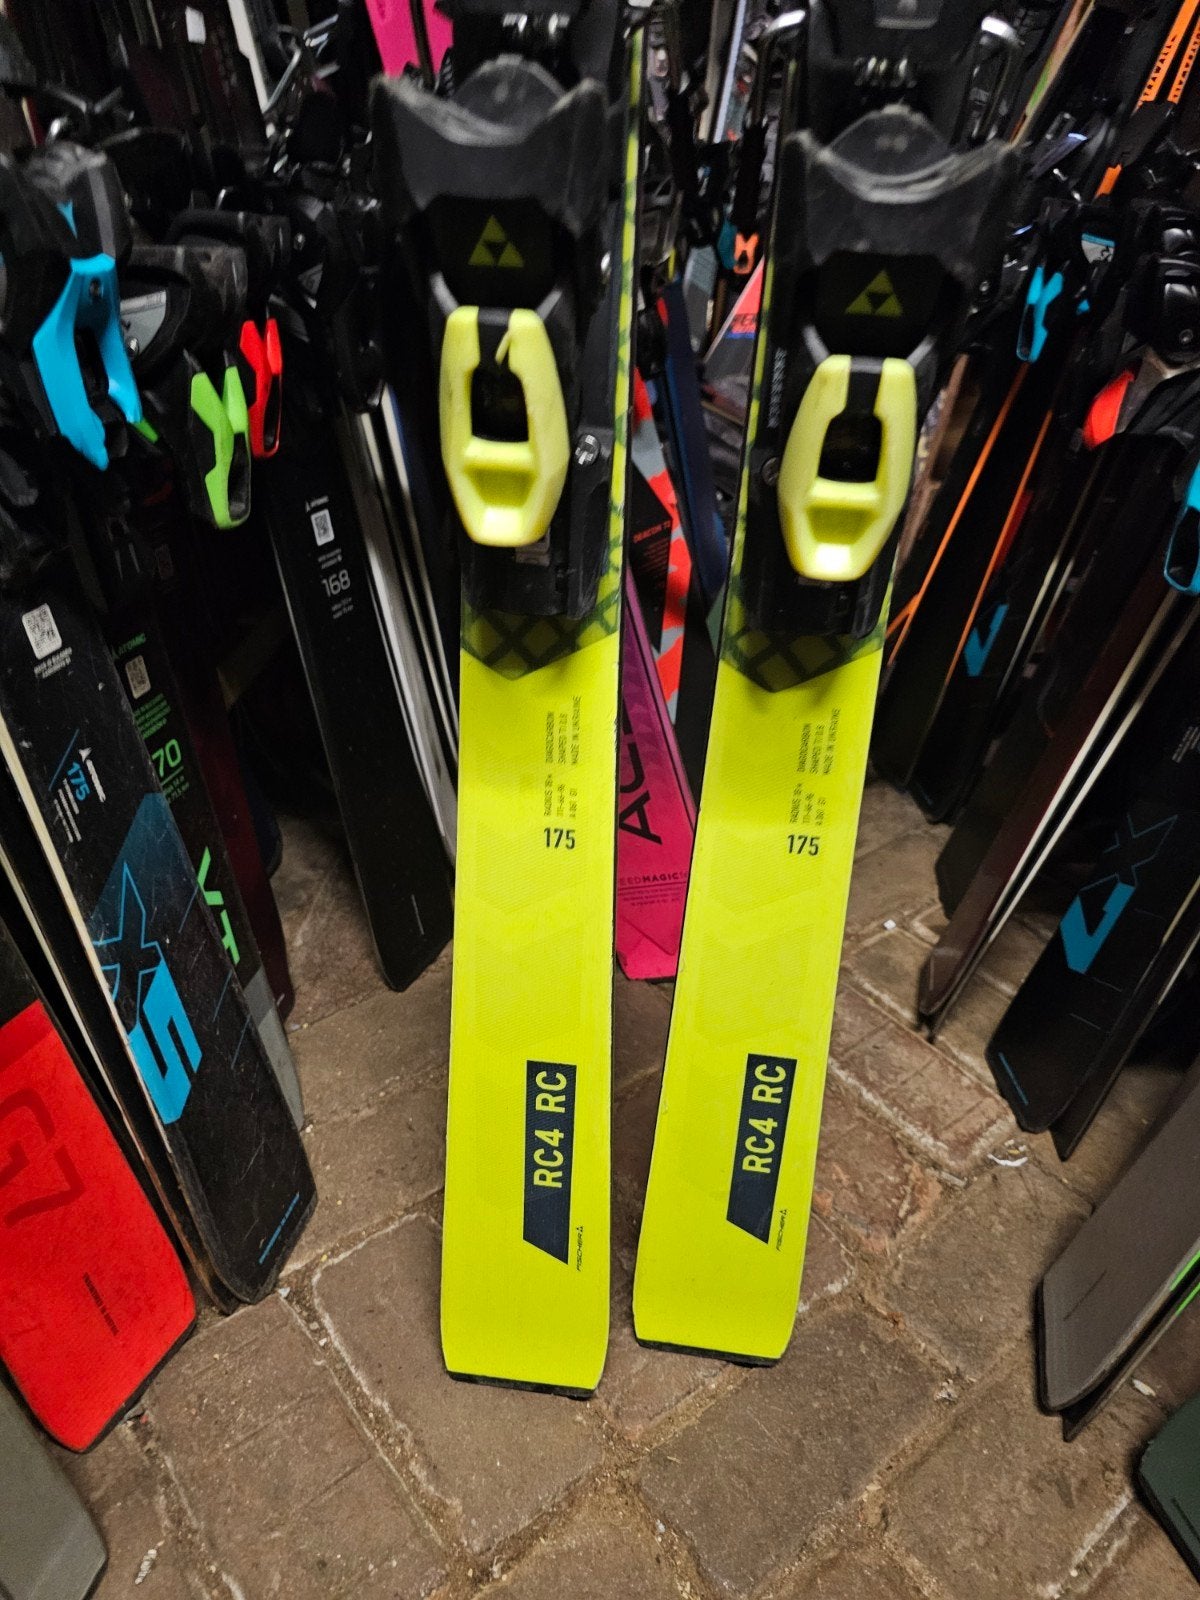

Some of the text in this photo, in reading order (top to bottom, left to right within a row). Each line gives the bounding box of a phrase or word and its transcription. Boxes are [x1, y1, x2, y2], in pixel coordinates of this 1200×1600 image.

[1143, 45, 1172, 96] TRAWALL
[322, 569, 351, 597] 168
[118, 632, 147, 655] ATOMIC
[151, 738, 182, 778] 70
[66, 761, 91, 801] 175
[543, 828, 576, 850] 175
[787, 834, 820, 856] 175
[533, 1070, 567, 1188] RC4 RC
[742, 1063, 787, 1174] RC4 RC
[576, 1231, 584, 1272] FISCHER
[776, 1213, 787, 1251] FISCHER
